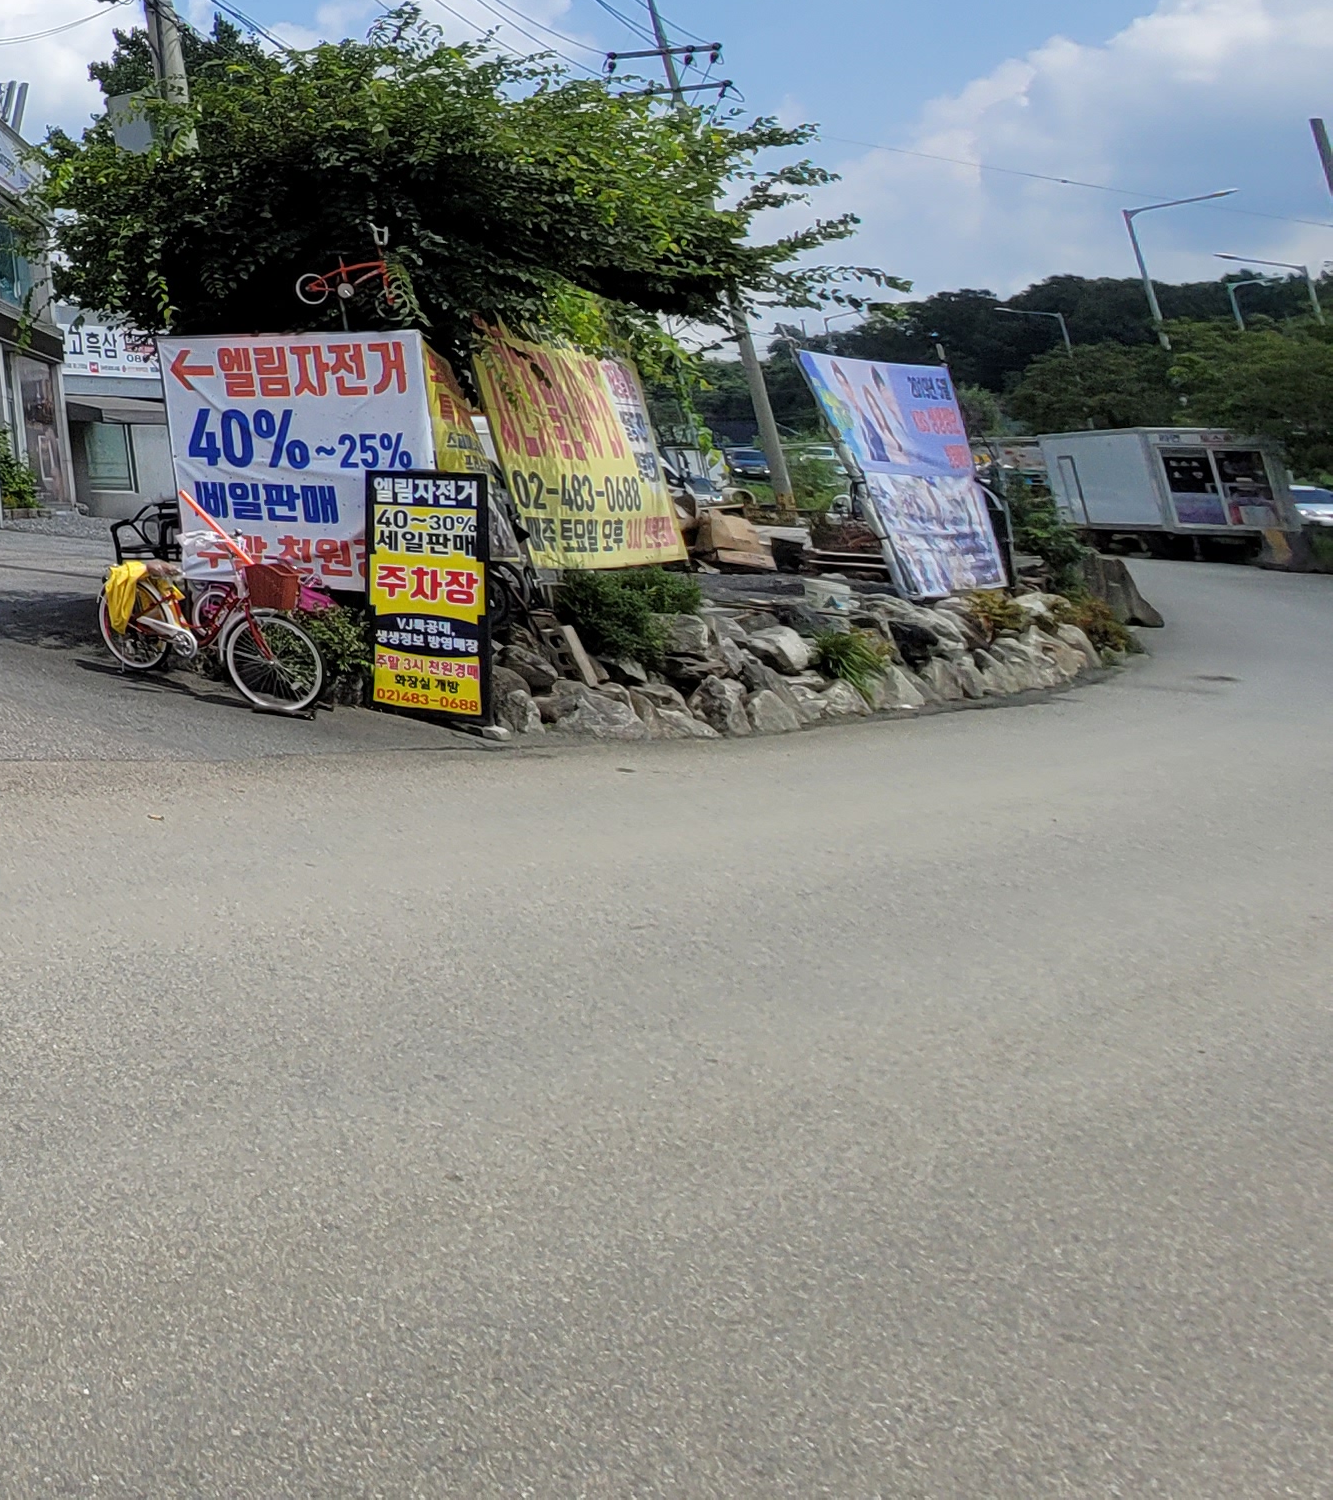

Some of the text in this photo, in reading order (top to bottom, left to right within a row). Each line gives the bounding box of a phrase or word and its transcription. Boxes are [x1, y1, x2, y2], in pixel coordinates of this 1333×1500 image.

[218, 341, 408, 398] 엘림자전거
[374, 477, 477, 507] 엘림자전거
[513, 469, 642, 513] 02-483-0688
[376, 509, 478, 533] 40~30%
[375, 530, 476, 557] 세일판매
[560, 517, 599, 553] 토요일
[602, 518, 624, 552] 오후
[376, 565, 479, 605] 주차장
[375, 629, 478, 654] 생생정보 방영매장
[376, 653, 479, 680] 주말 3시 천원경매
[394, 673, 459, 694] 화장실 개방
[376, 686, 479, 712] 02)483-0688
